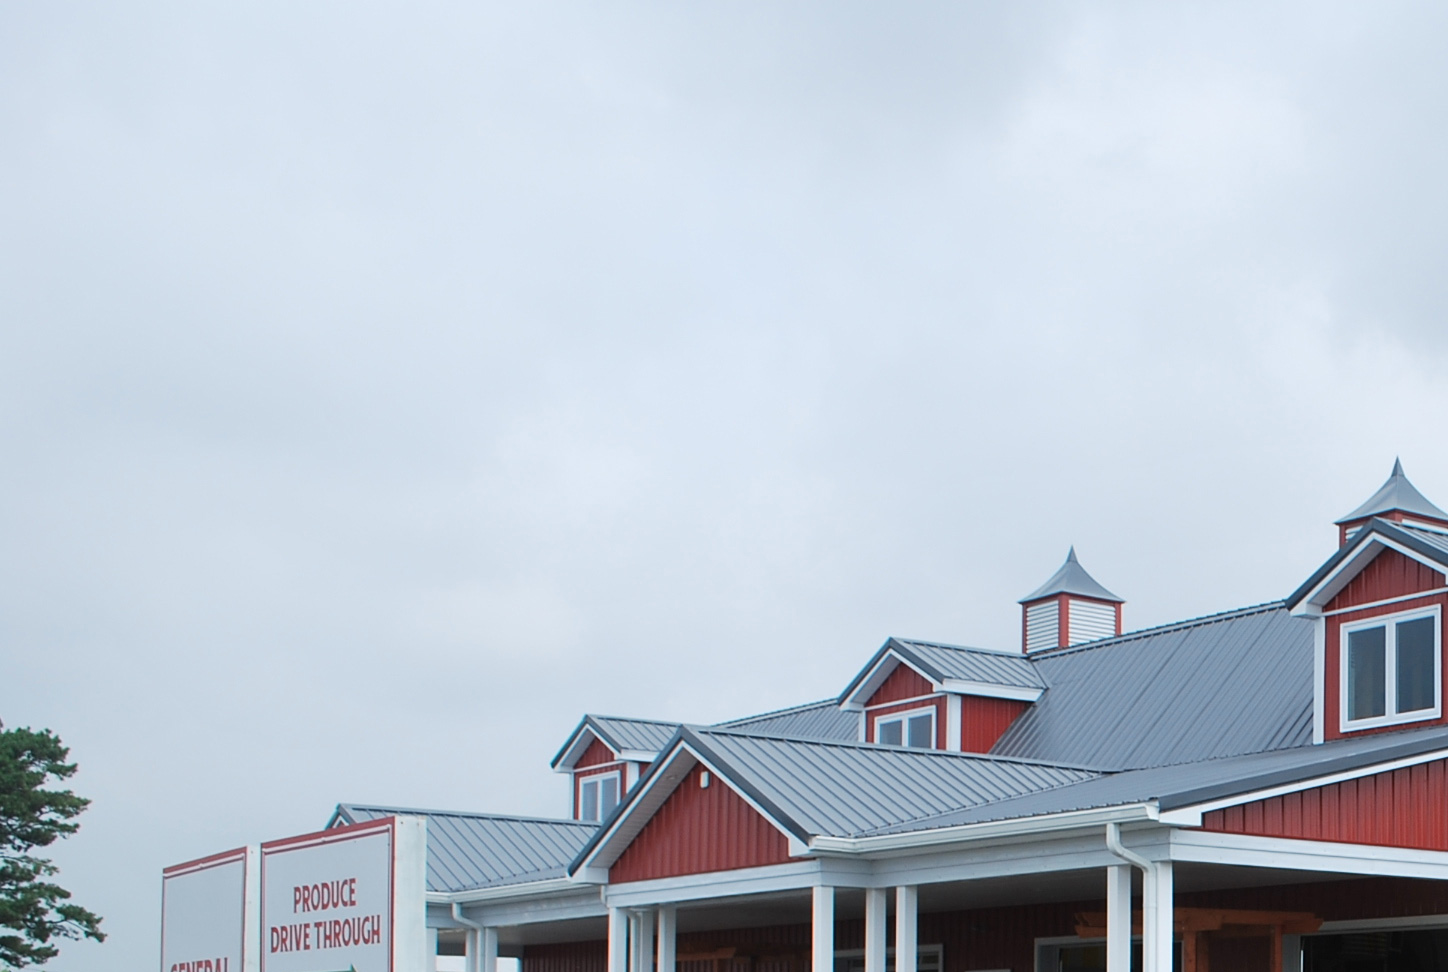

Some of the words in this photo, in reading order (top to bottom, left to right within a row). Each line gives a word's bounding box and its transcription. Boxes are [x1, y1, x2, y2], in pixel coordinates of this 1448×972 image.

[293, 878, 357, 913] PRODUCE
[270, 922, 311, 953] DRIVE
[314, 914, 381, 948] THROUGH
